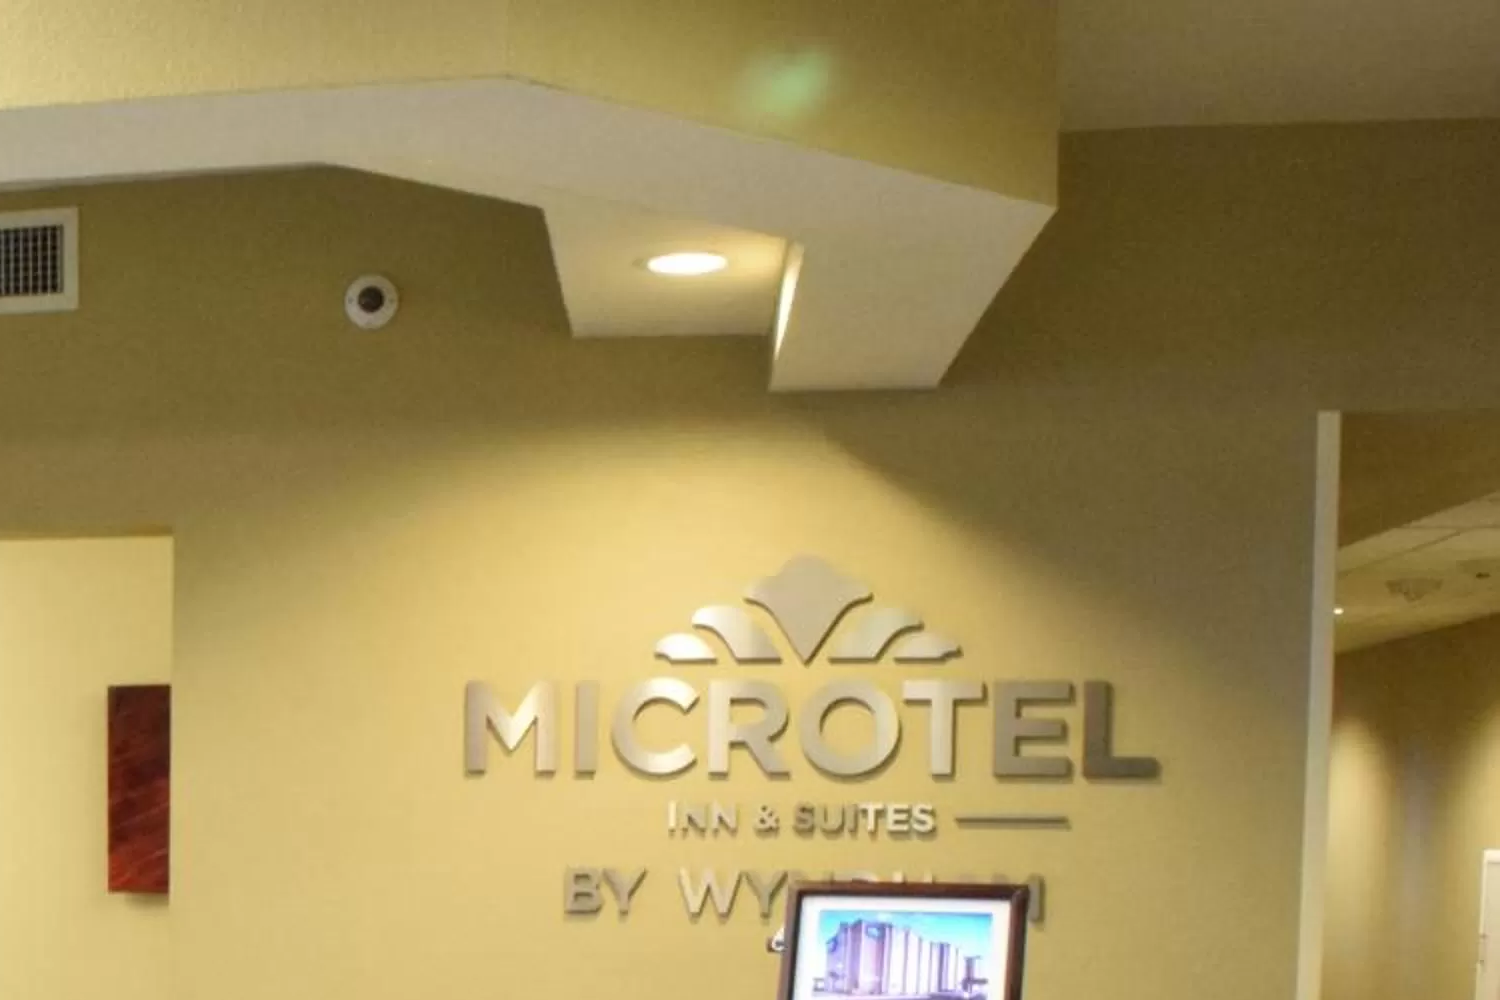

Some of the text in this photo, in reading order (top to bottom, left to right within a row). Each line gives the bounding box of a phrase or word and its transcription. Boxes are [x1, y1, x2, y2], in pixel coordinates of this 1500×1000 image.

[464, 677, 1161, 779] MICROTEL
[666, 802, 938, 837] INN & SUITES
[564, 867, 648, 918] BY
